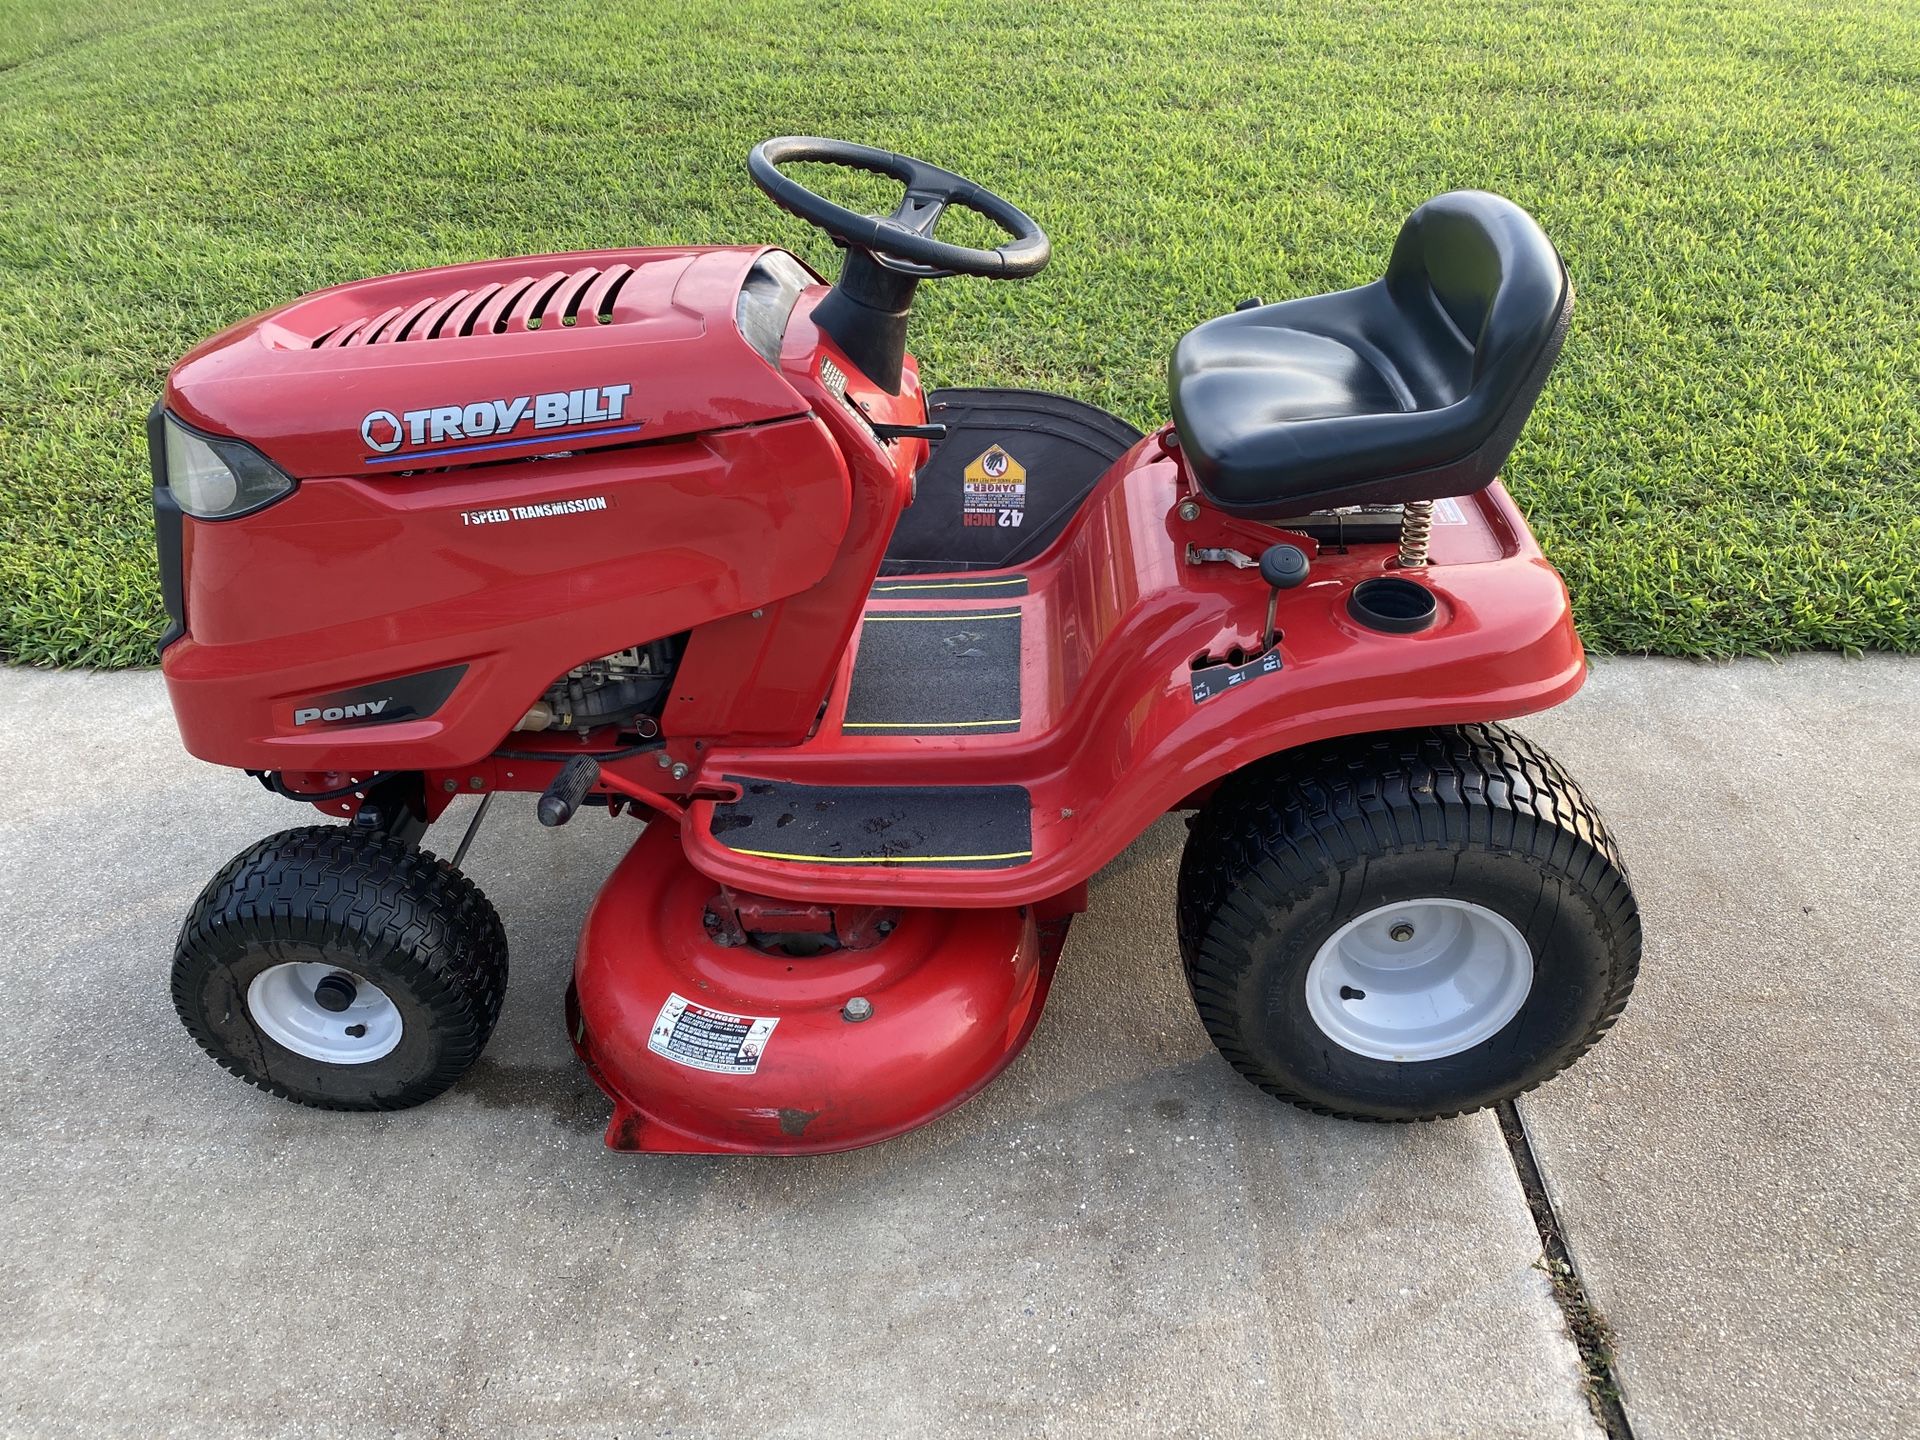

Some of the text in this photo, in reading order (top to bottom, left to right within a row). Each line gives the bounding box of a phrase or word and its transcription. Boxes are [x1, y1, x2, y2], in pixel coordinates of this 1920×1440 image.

[403, 383, 631, 445] TROY-BILT
[461, 496, 607, 526] 7 SPEED TRANSMISSION
[964, 508, 1024, 528] 42 INCH
[1228, 672, 1242, 685] N
[1194, 692, 1206, 700] F
[294, 699, 389, 726] PONY
[702, 1011, 741, 1024] DANGER
